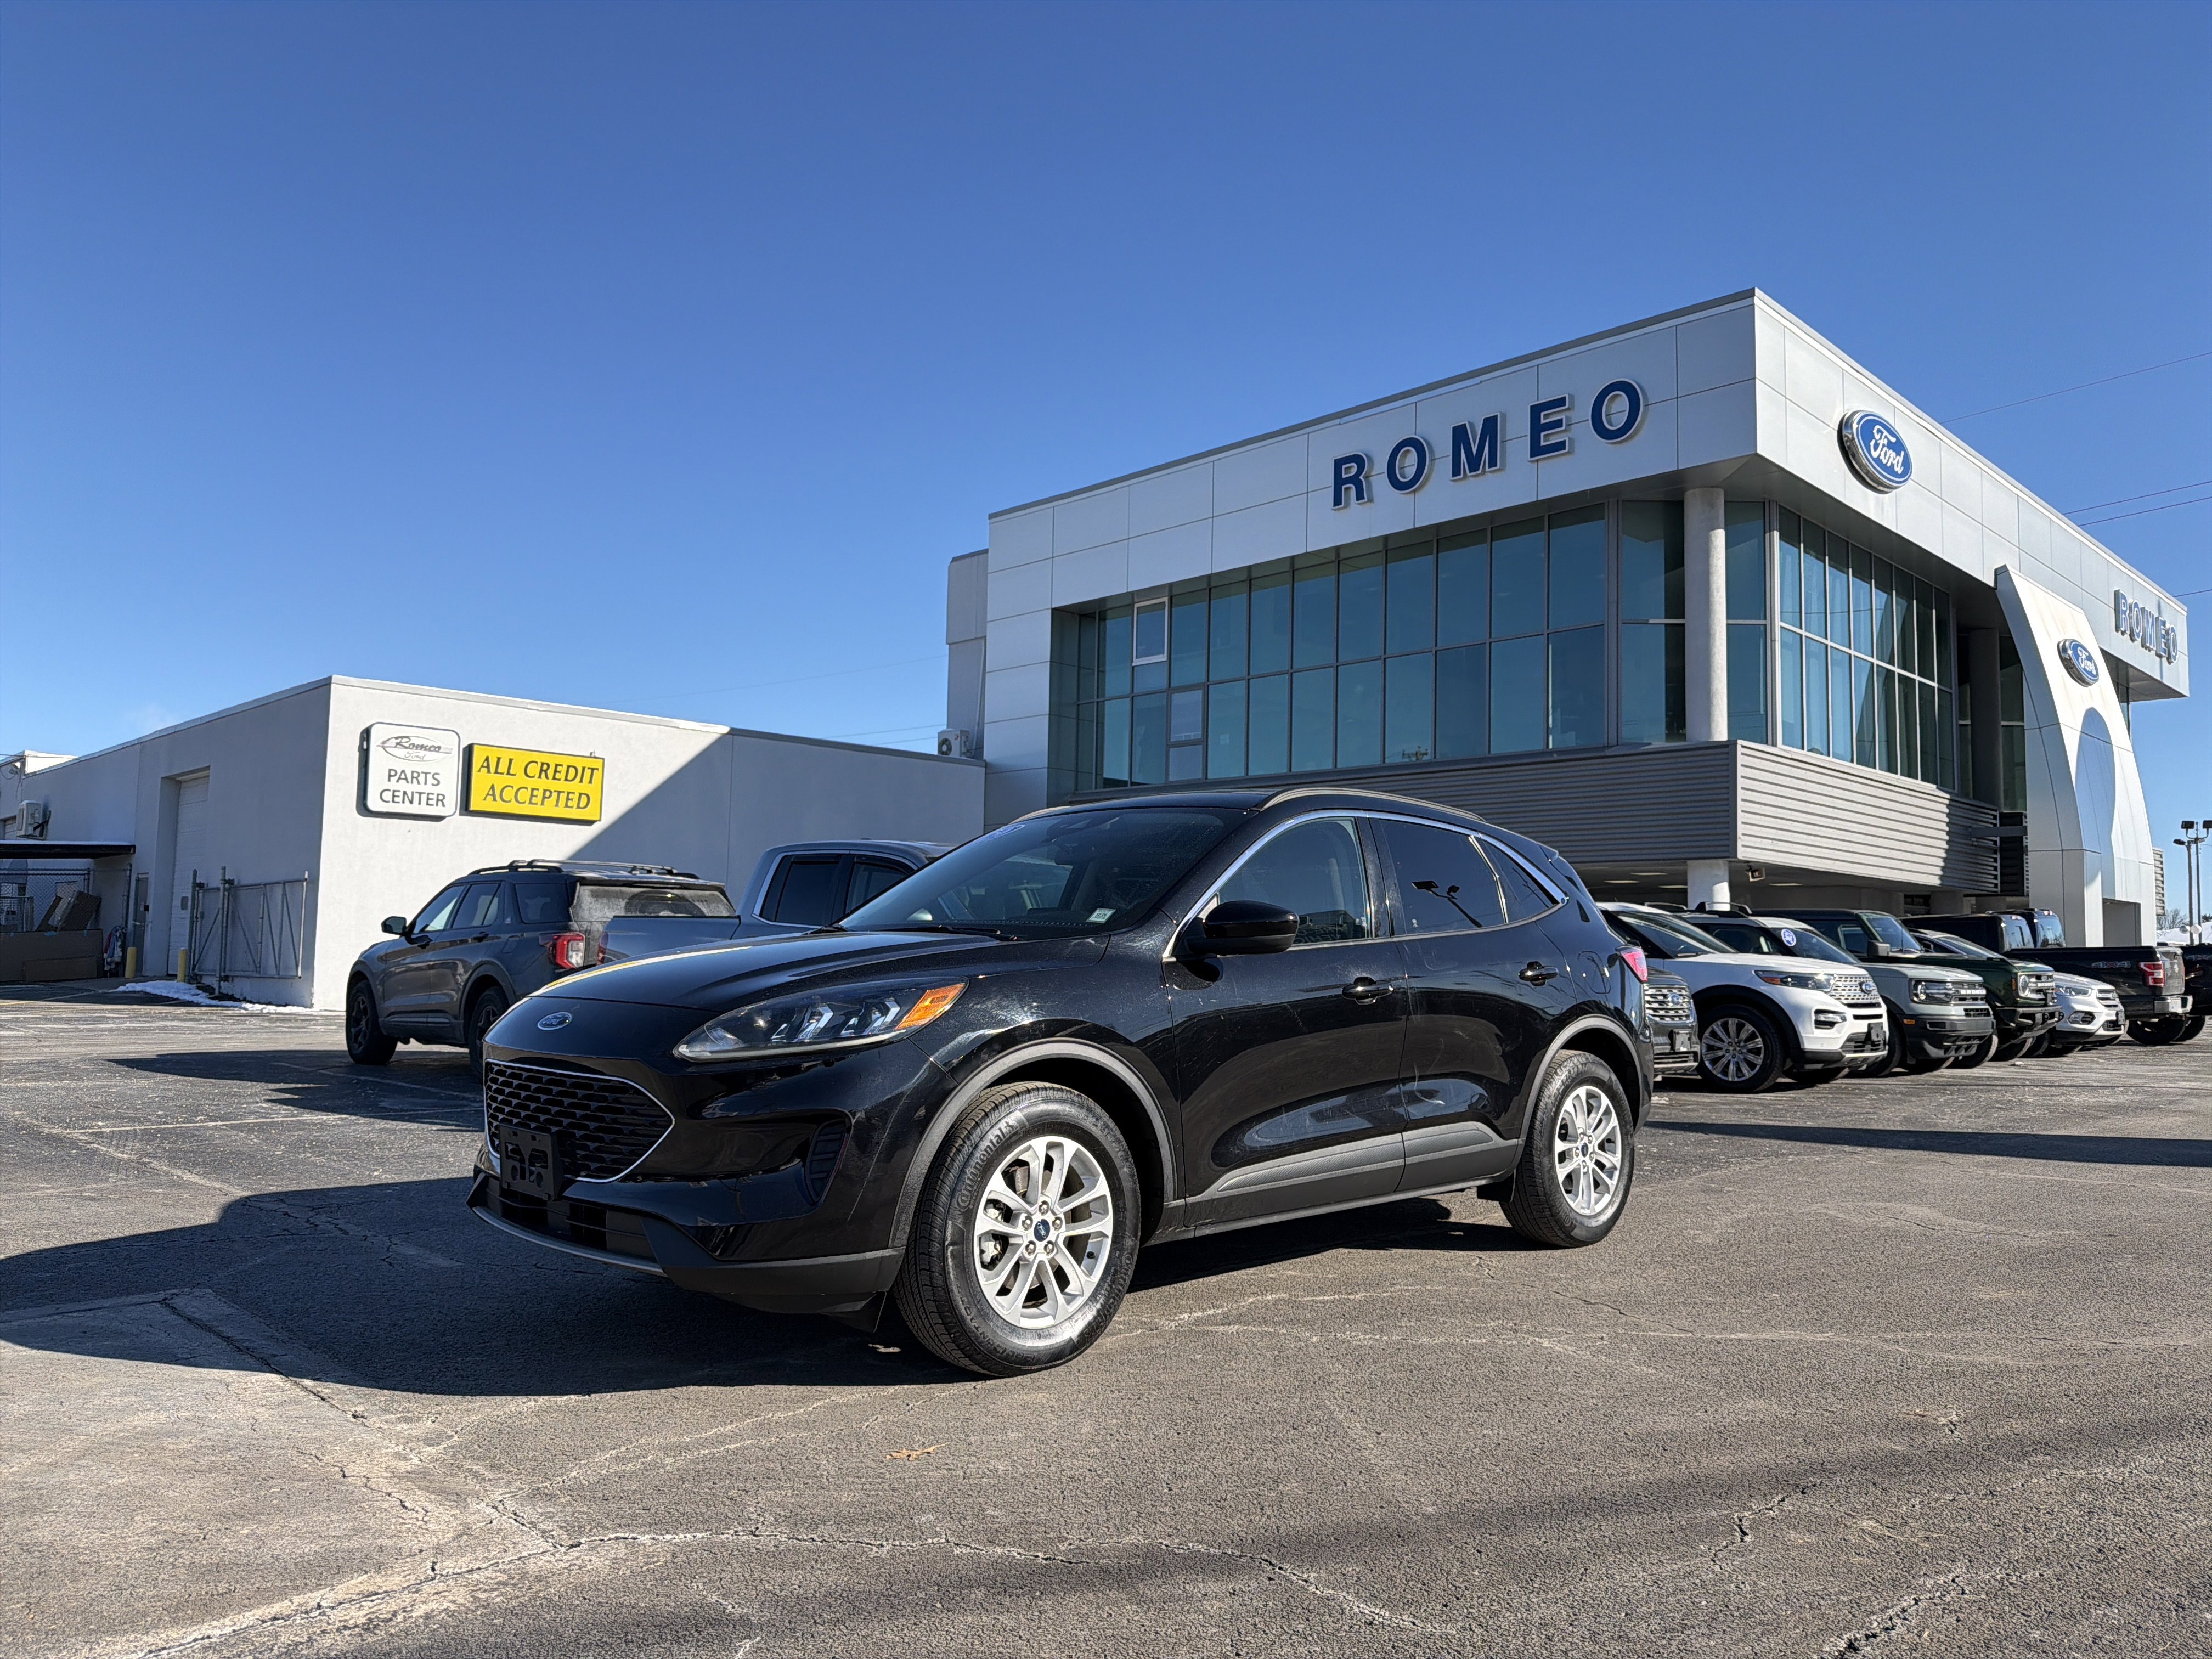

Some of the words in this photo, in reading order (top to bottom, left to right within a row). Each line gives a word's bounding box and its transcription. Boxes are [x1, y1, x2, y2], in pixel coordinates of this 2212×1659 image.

[1331, 377, 1645, 510] ROMEO
[1870, 425, 1905, 474] Ford
[2114, 589, 2179, 664] ROMEO
[2077, 646, 2096, 674] Ford
[394, 736, 442, 752] Romeo
[404, 751, 426, 760] Ford
[387, 768, 441, 786] PARTS
[477, 755, 517, 777] ALL
[523, 760, 599, 785] CREDIT
[380, 788, 446, 808] CENTER
[483, 783, 591, 810] ACCEPTED
